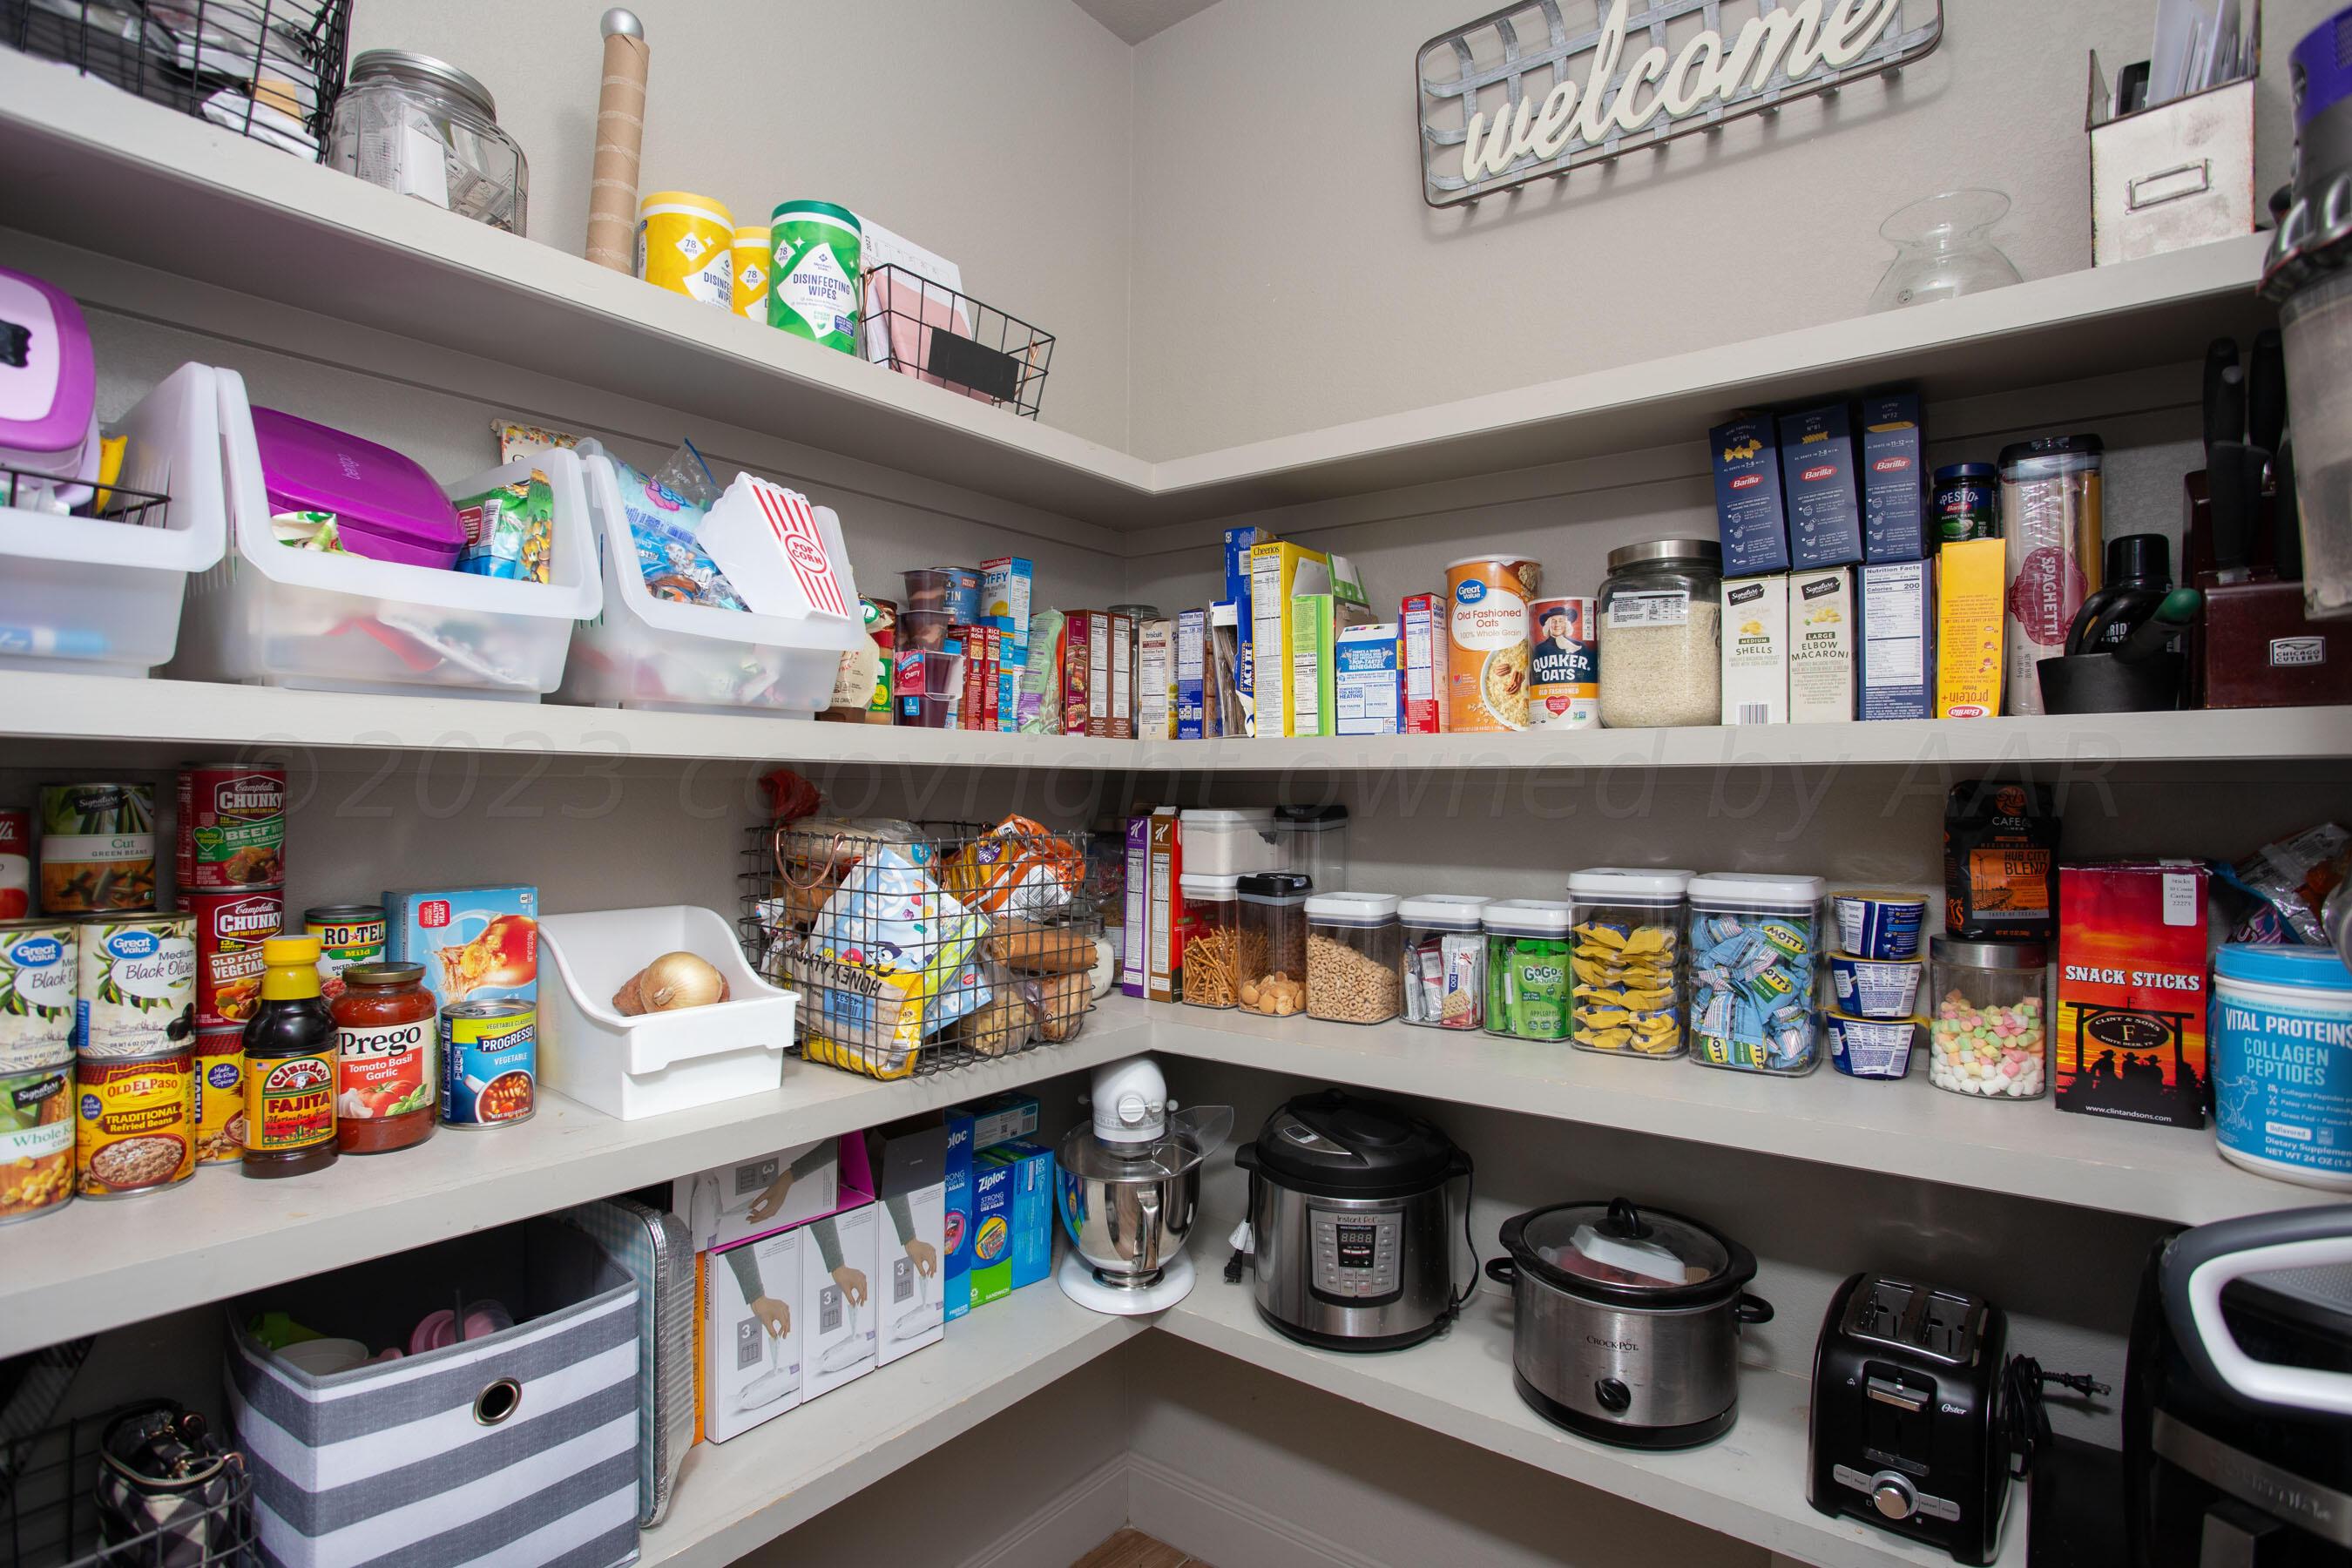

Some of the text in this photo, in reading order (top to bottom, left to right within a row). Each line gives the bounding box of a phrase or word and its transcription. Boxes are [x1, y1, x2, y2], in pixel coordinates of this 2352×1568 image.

[1462, 0, 1901, 182] welcome
[686, 240, 697, 249] 78
[780, 247, 787, 256] 78
[747, 270, 758, 279] 78
[794, 274, 850, 295] DISINFECTING
[808, 286, 836, 301] WIPES
[1876, 460, 1907, 470] Barilla
[1805, 469, 1833, 479] Barilla
[1734, 476, 1759, 488] Barilla
[1942, 491, 1975, 505] PESTO
[793, 542, 814, 555] POP
[1254, 545, 1280, 556] Cheerios
[792, 550, 822, 566] CORN
[1458, 585, 1481, 594] Great
[1806, 581, 1835, 593] Signature
[1732, 588, 1759, 600] Signature
[2042, 557, 2058, 636] SPAGHETTI
[1456, 609, 1521, 621] Old Fashioned
[1477, 618, 1498, 627] Oats
[1736, 646, 1773, 655] SHELLS
[1802, 641, 1838, 651] ELBOW
[1792, 651, 1848, 661] MACARONI
[1243, 649, 1253, 686] ACT II
[1533, 654, 1588, 672] QUAKER
[905, 669, 920, 679] Cherry
[1542, 669, 1575, 681] OATS
[1950, 708, 1980, 717] Barilla
[79, 795, 118, 808] Signature
[220, 791, 282, 808] CHUNKY
[1992, 817, 2021, 826] CAFE
[226, 826, 270, 840] BEEF
[112, 839, 134, 848] Cut
[2004, 850, 2048, 862] HUB CITY
[2004, 862, 2048, 875] BLEND
[220, 912, 281, 932] CHUNKY
[113, 937, 151, 949] Great
[17, 944, 56, 957] Great
[122, 945, 151, 954] Value
[159, 950, 193, 961] Medium
[345, 949, 370, 957] Mild
[27, 953, 56, 963] Value
[212, 957, 235, 966] OLD
[125, 960, 194, 980] Black Olives
[32, 970, 66, 989] Black
[2065, 965, 2200, 991] SNACK STICKS
[2095, 1017, 2123, 1025] CLINT
[2134, 1018, 2160, 1031] SONS
[2225, 1007, 2260, 1031] VITAL
[486, 1021, 514, 1030] VEGETABLE
[483, 1025, 533, 1051] PROGRESSO
[2122, 1025, 2135, 1041] F
[2100, 1035, 2121, 1045] WHITE
[2244, 1037, 2328, 1067] COLLAGEN
[349, 1053, 413, 1072] Tomato Basil
[495, 1052, 527, 1065] VEGETABLE
[214, 1064, 230, 1073] Made
[271, 1061, 327, 1086] Claude's
[366, 1068, 398, 1081] Garlic
[2247, 1057, 2326, 1086] PEPTIDES
[213, 1077, 235, 1087] Spices
[18, 1082, 59, 1101] Signature
[108, 1085, 131, 1098] OLD
[133, 1081, 148, 1090] EL
[2281, 1088, 2312, 1098] Collagen
[268, 1092, 330, 1113] FAJITA
[105, 1107, 178, 1124] TRADITIONAL
[2085, 1104, 2173, 1123] www.clintandsons.com
[111, 1117, 172, 1132] Refried Beans
[2269, 1125, 2306, 1136] Unflavored
[14, 1130, 61, 1147] Whole
[52, 1138, 70, 1147] CORN
[2266, 1136, 2297, 1149] Dietary
[2266, 1146, 2333, 1166] NET WT 24 OZ
[945, 1170, 965, 1181] RONG
[948, 1182, 965, 1192] AGAIN
[978, 1171, 1006, 1193] Ziploc
[981, 1192, 1004, 1203] STRONG
[990, 1201, 1004, 1210] AGAIN
[985, 1288, 1010, 1301] SANDWICH
[1942, 1403, 1967, 1415] Oster
